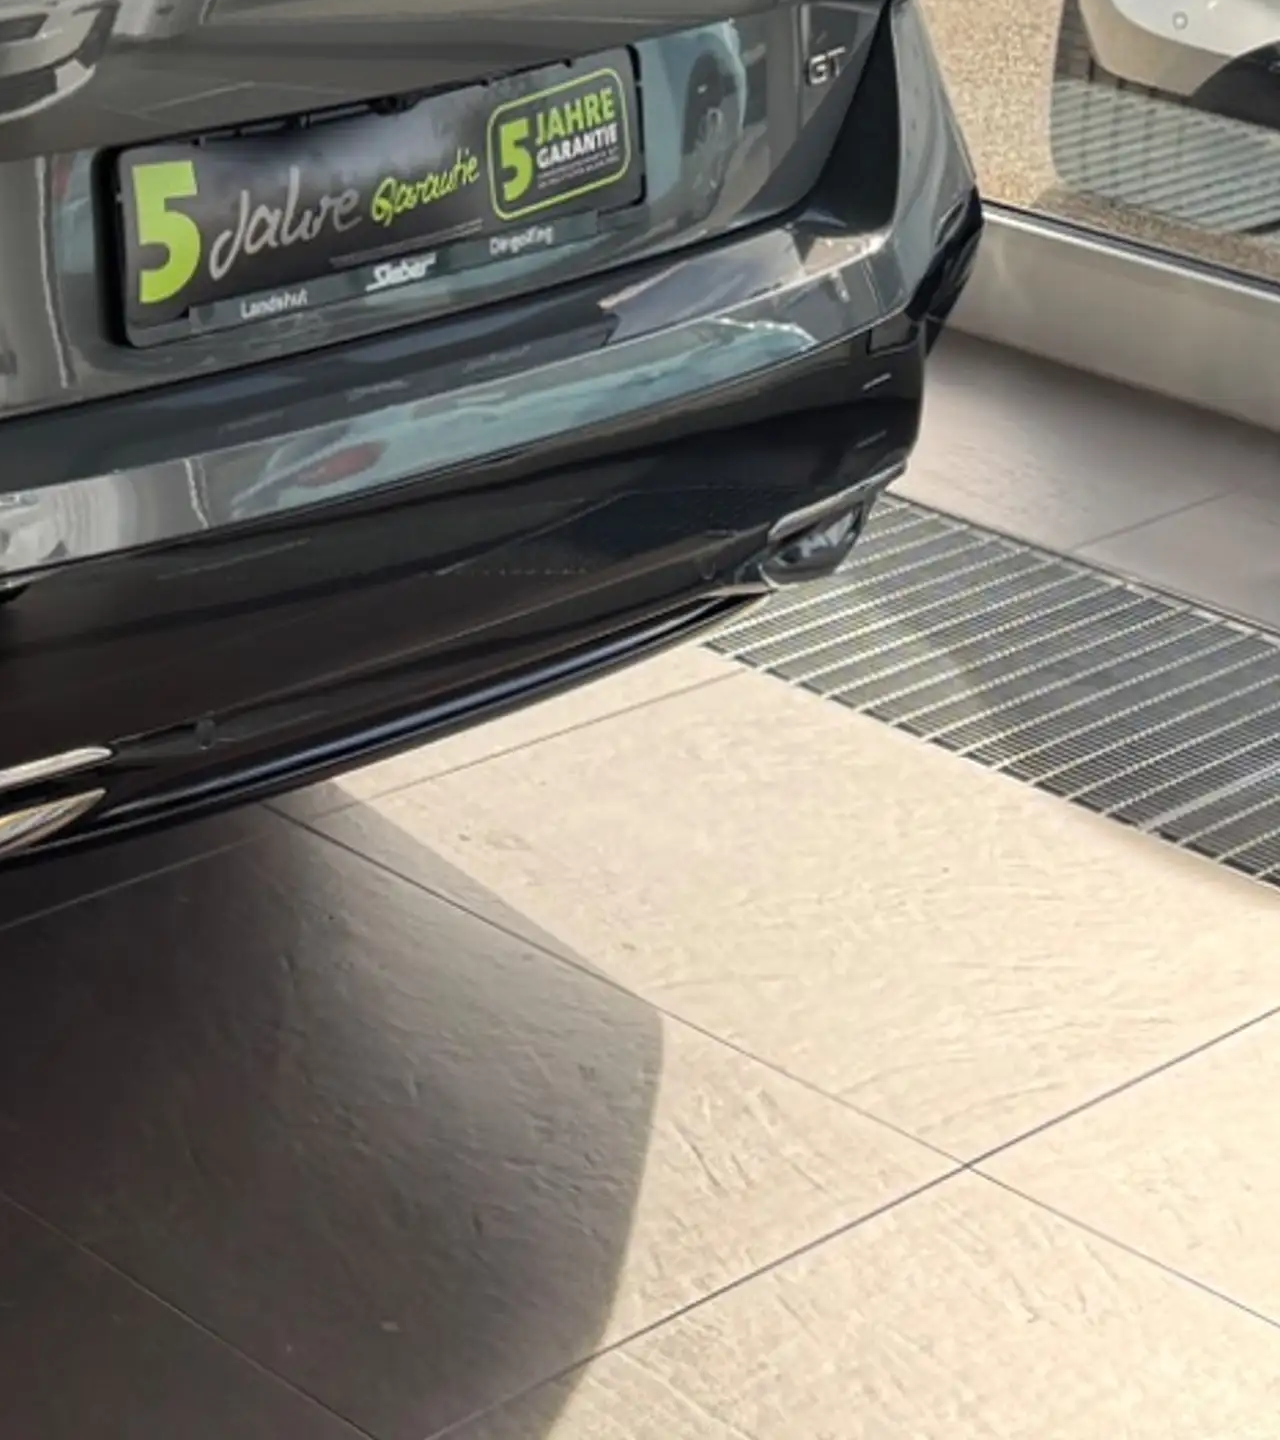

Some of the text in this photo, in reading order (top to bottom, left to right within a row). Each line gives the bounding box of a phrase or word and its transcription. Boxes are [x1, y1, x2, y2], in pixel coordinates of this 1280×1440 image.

[534, 86, 616, 147] JAHRE
[536, 121, 619, 170] GARANTIE
[500, 116, 533, 202] 5
[132, 159, 202, 305] 5
[208, 164, 363, 282] Jahre
[240, 287, 309, 320] Landshut
